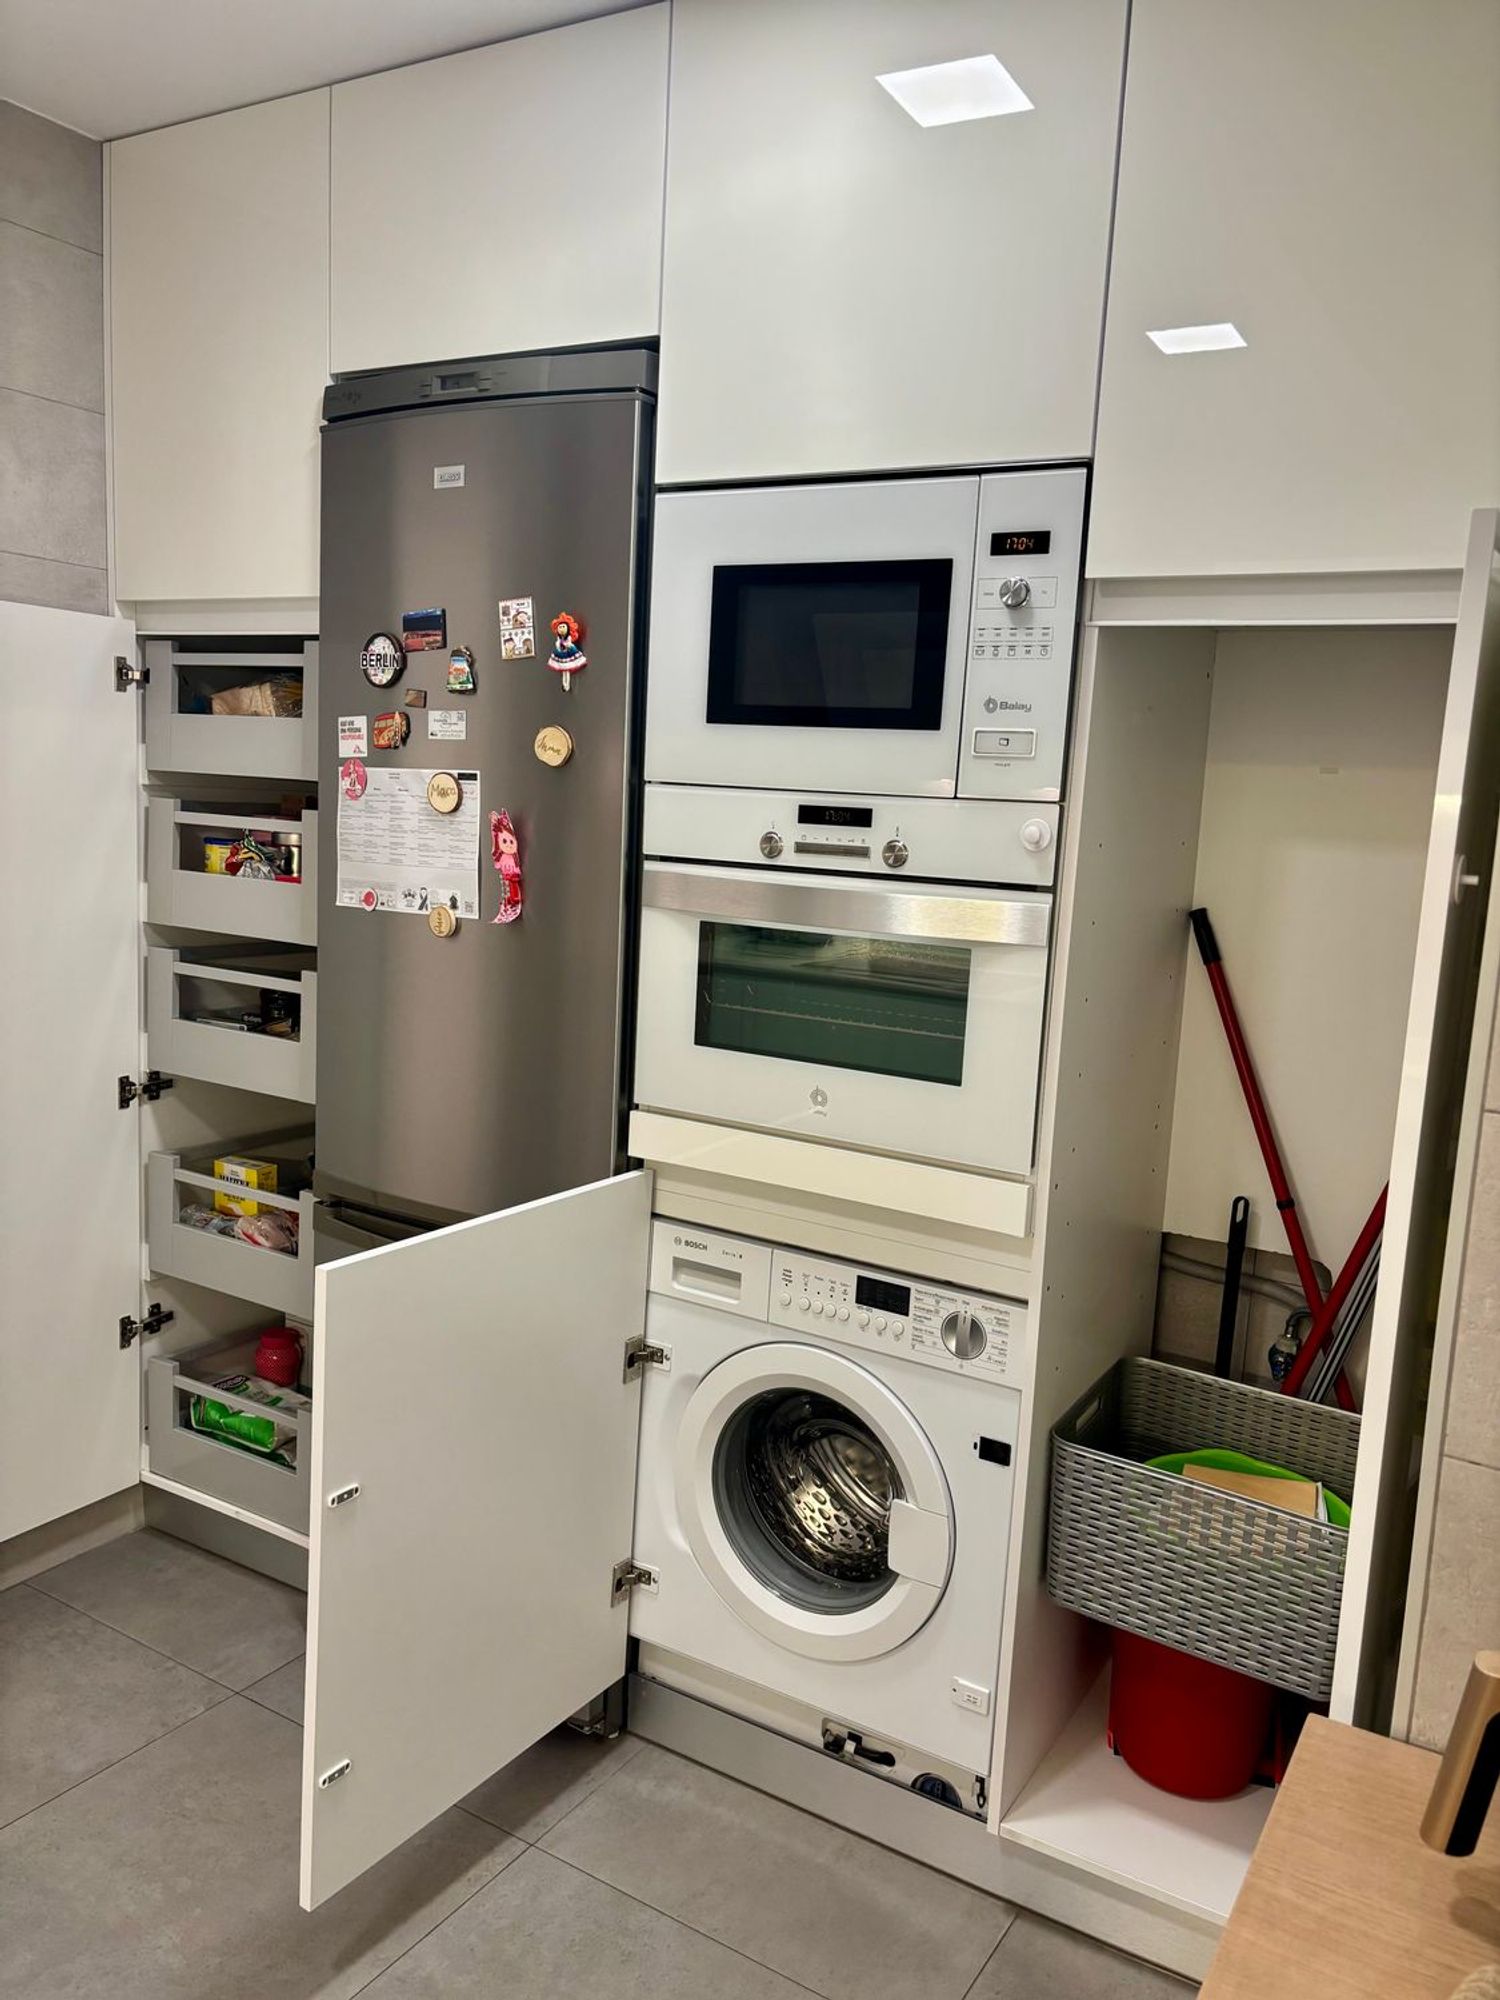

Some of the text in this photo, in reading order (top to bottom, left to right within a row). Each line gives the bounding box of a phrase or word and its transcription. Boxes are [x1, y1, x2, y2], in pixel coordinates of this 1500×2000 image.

[360, 652, 400, 669] BERLIN
[1000, 701, 1032, 713] Balay
[684, 1240, 708, 1251] BOSCH
